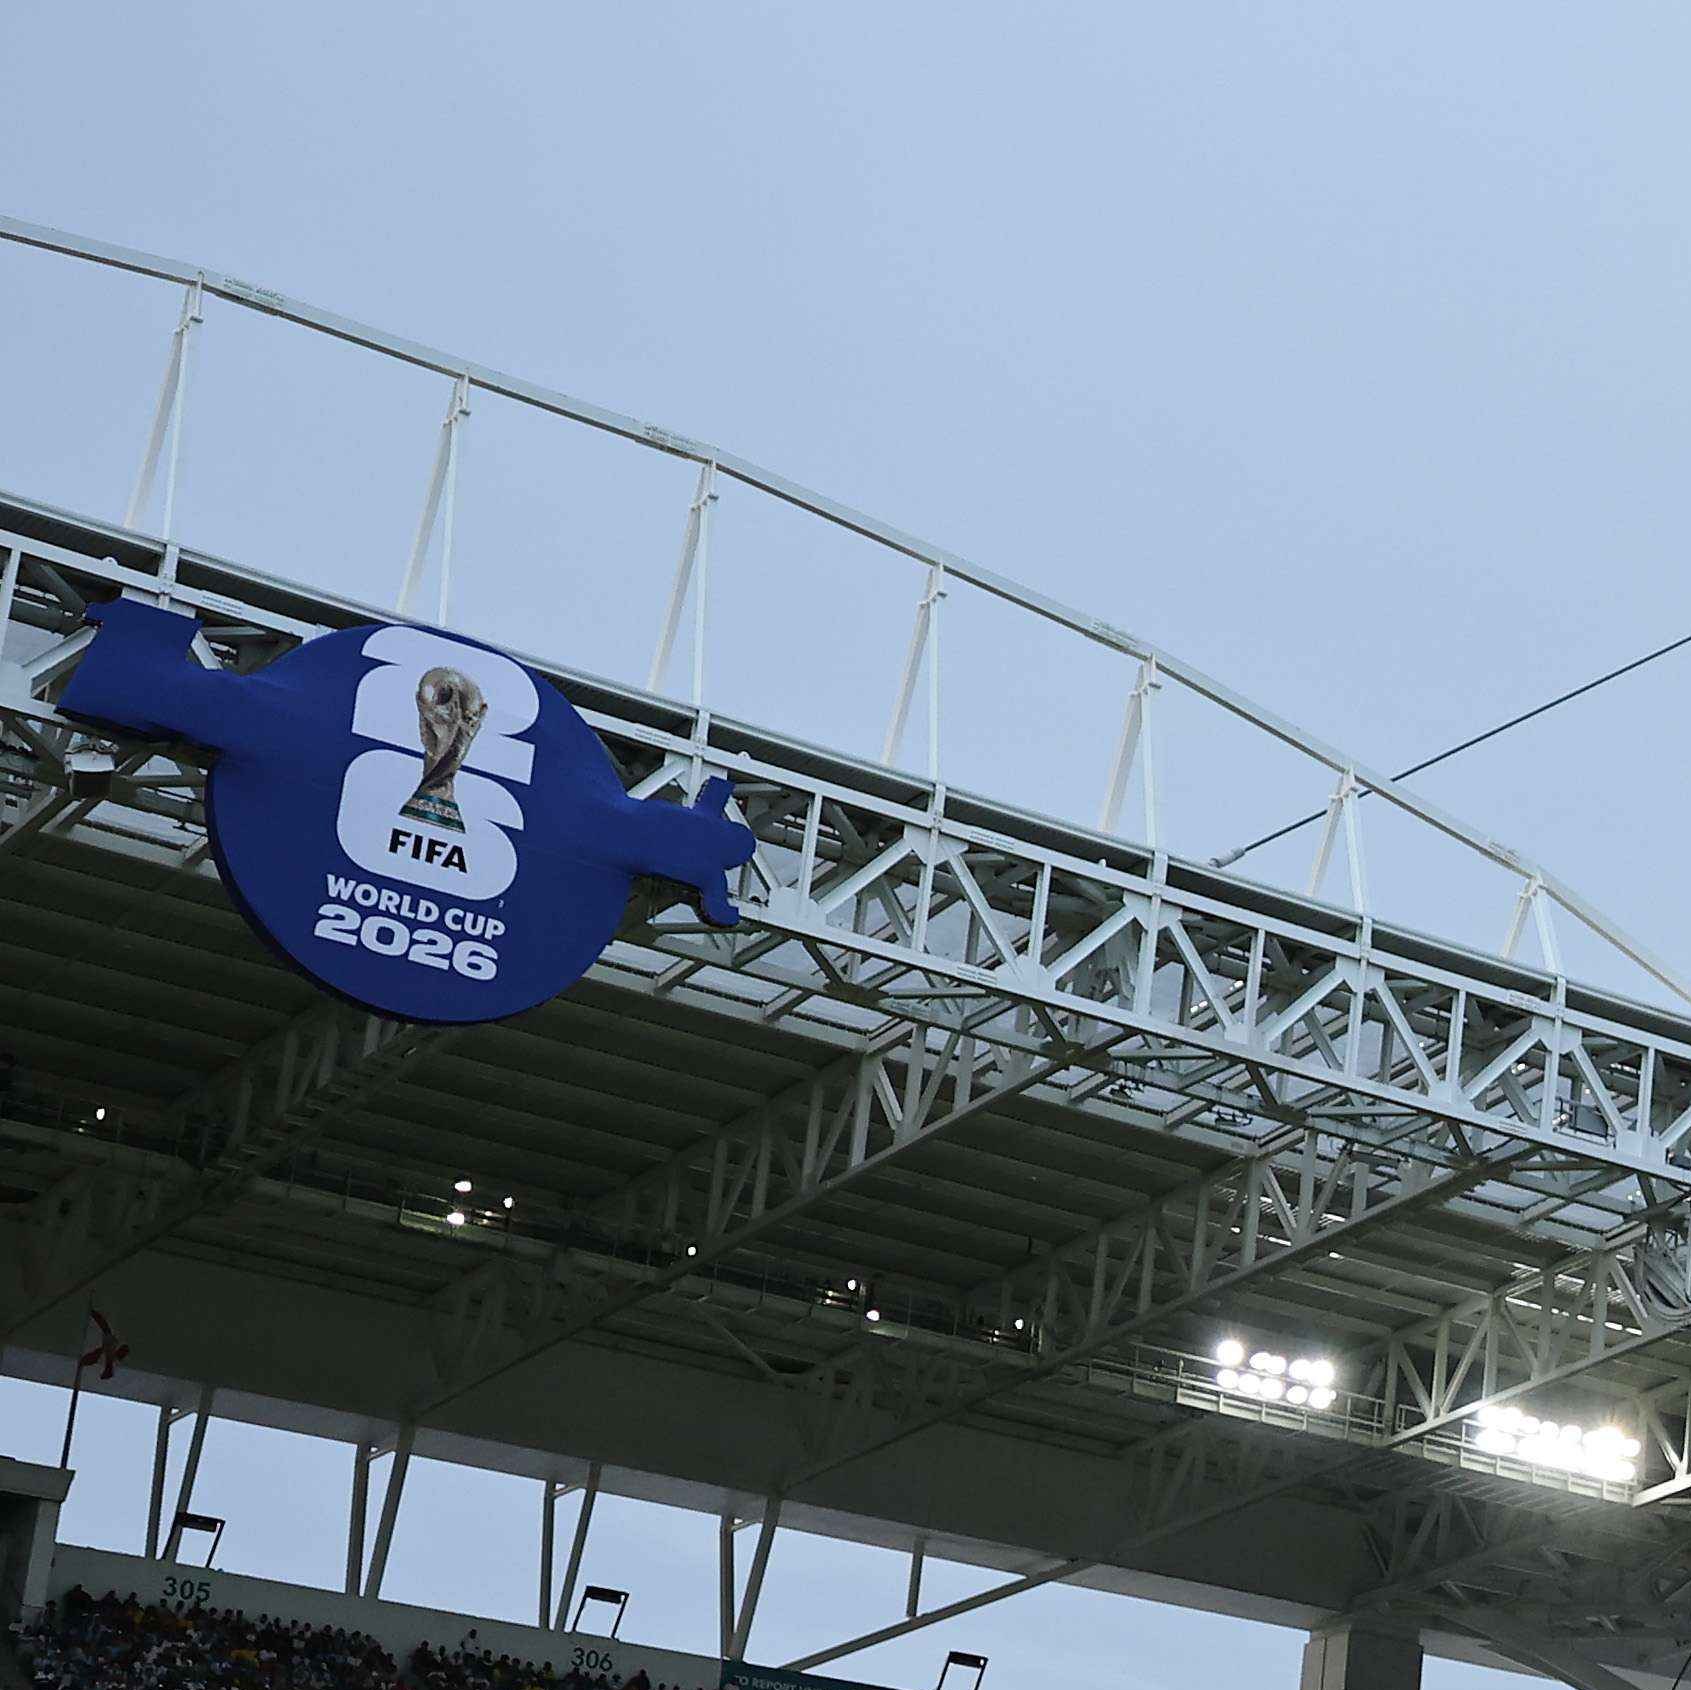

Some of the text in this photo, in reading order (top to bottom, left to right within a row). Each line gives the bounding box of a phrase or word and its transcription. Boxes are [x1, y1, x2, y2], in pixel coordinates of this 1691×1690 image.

[388, 828, 468, 873] FIFA
[327, 874, 506, 940] WORLD CUP
[314, 903, 499, 981] 2026
[163, 1577, 211, 1601] 305
[572, 1649, 613, 1671] 306
